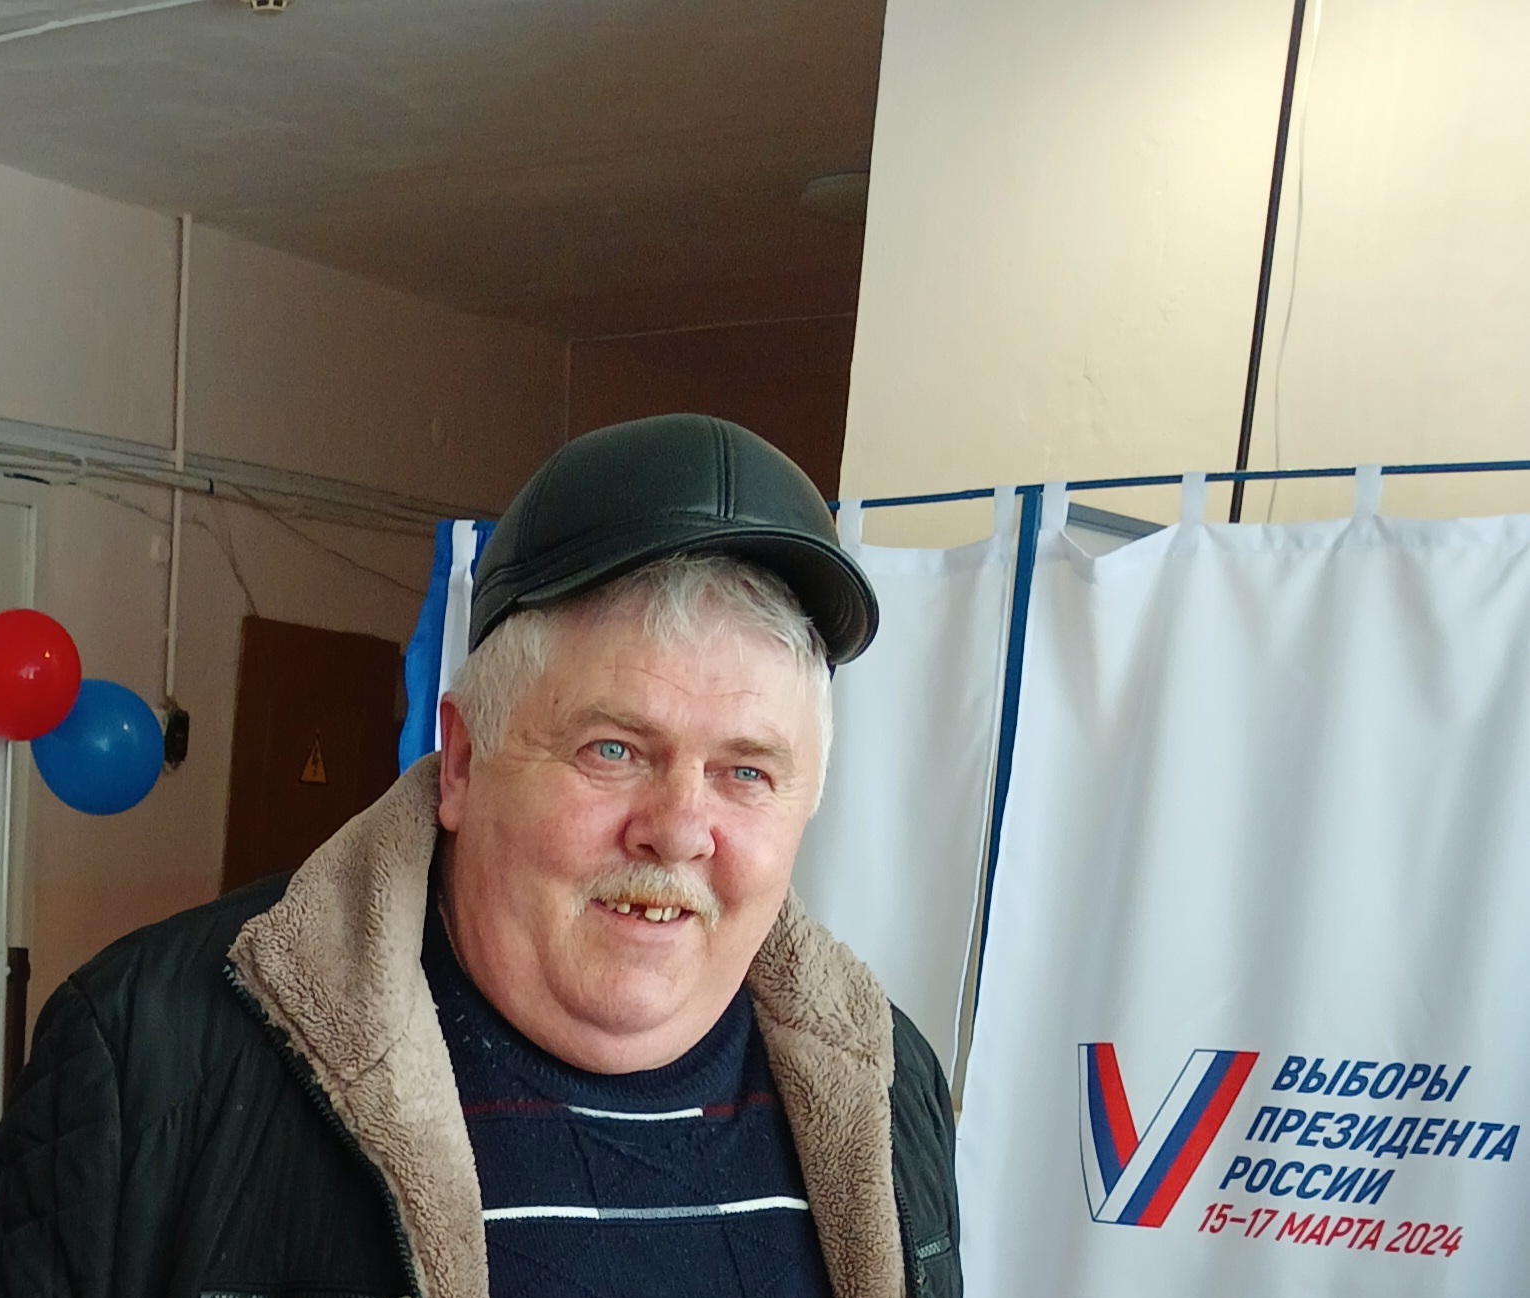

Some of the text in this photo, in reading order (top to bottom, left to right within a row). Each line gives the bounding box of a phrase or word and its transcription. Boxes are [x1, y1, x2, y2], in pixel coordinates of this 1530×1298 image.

[1271, 1055, 1472, 1102] ВЫБОРЫ
[1245, 1106, 1521, 1162] ПРЕЗИДЕНТА
[1219, 1156, 1395, 1205] РОССИИ
[1275, 1211, 1384, 1252] МАРТА
[1384, 1221, 1465, 1257] 2024
